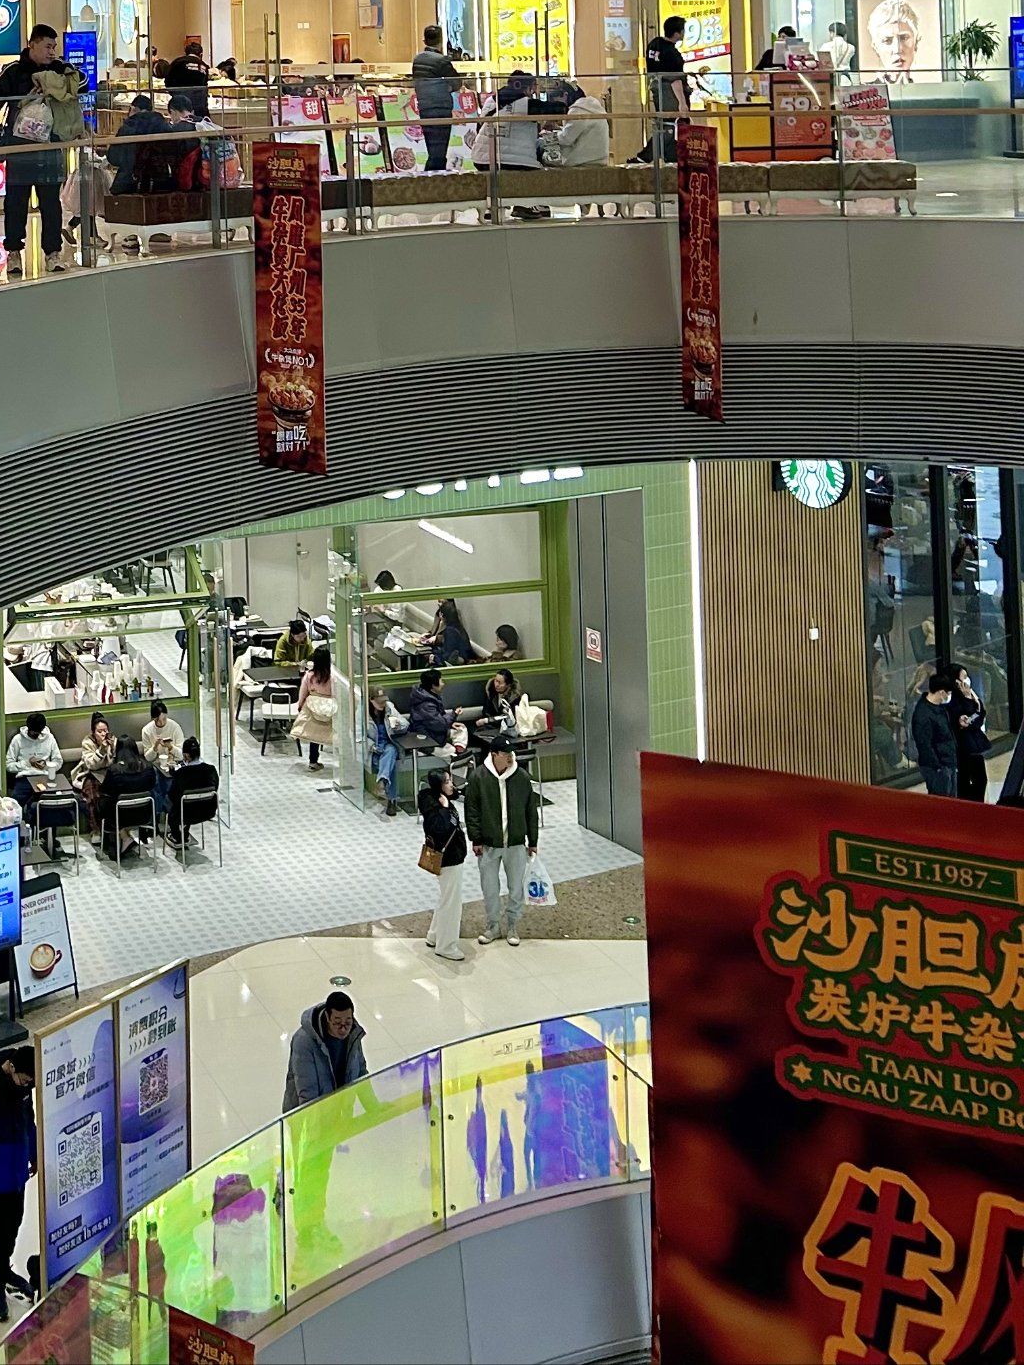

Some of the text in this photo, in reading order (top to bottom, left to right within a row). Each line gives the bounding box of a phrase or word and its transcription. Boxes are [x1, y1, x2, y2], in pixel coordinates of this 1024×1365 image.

[304, 101, 320, 116] 甜
[37, 894, 57, 906] COFFEE
[128, 1005, 167, 1039] 消费积分
[806, 978, 1022, 1062] 炭炉牛杂
[46, 1058, 76, 1086] 印象城
[56, 1066, 96, 1099] 官方微信
[865, 1052, 1013, 1101] TAAN LUO
[823, 1069, 900, 1104] NGAU
[910, 1087, 988, 1122] ZAAP
[803, 1162, 957, 1365] 牛
